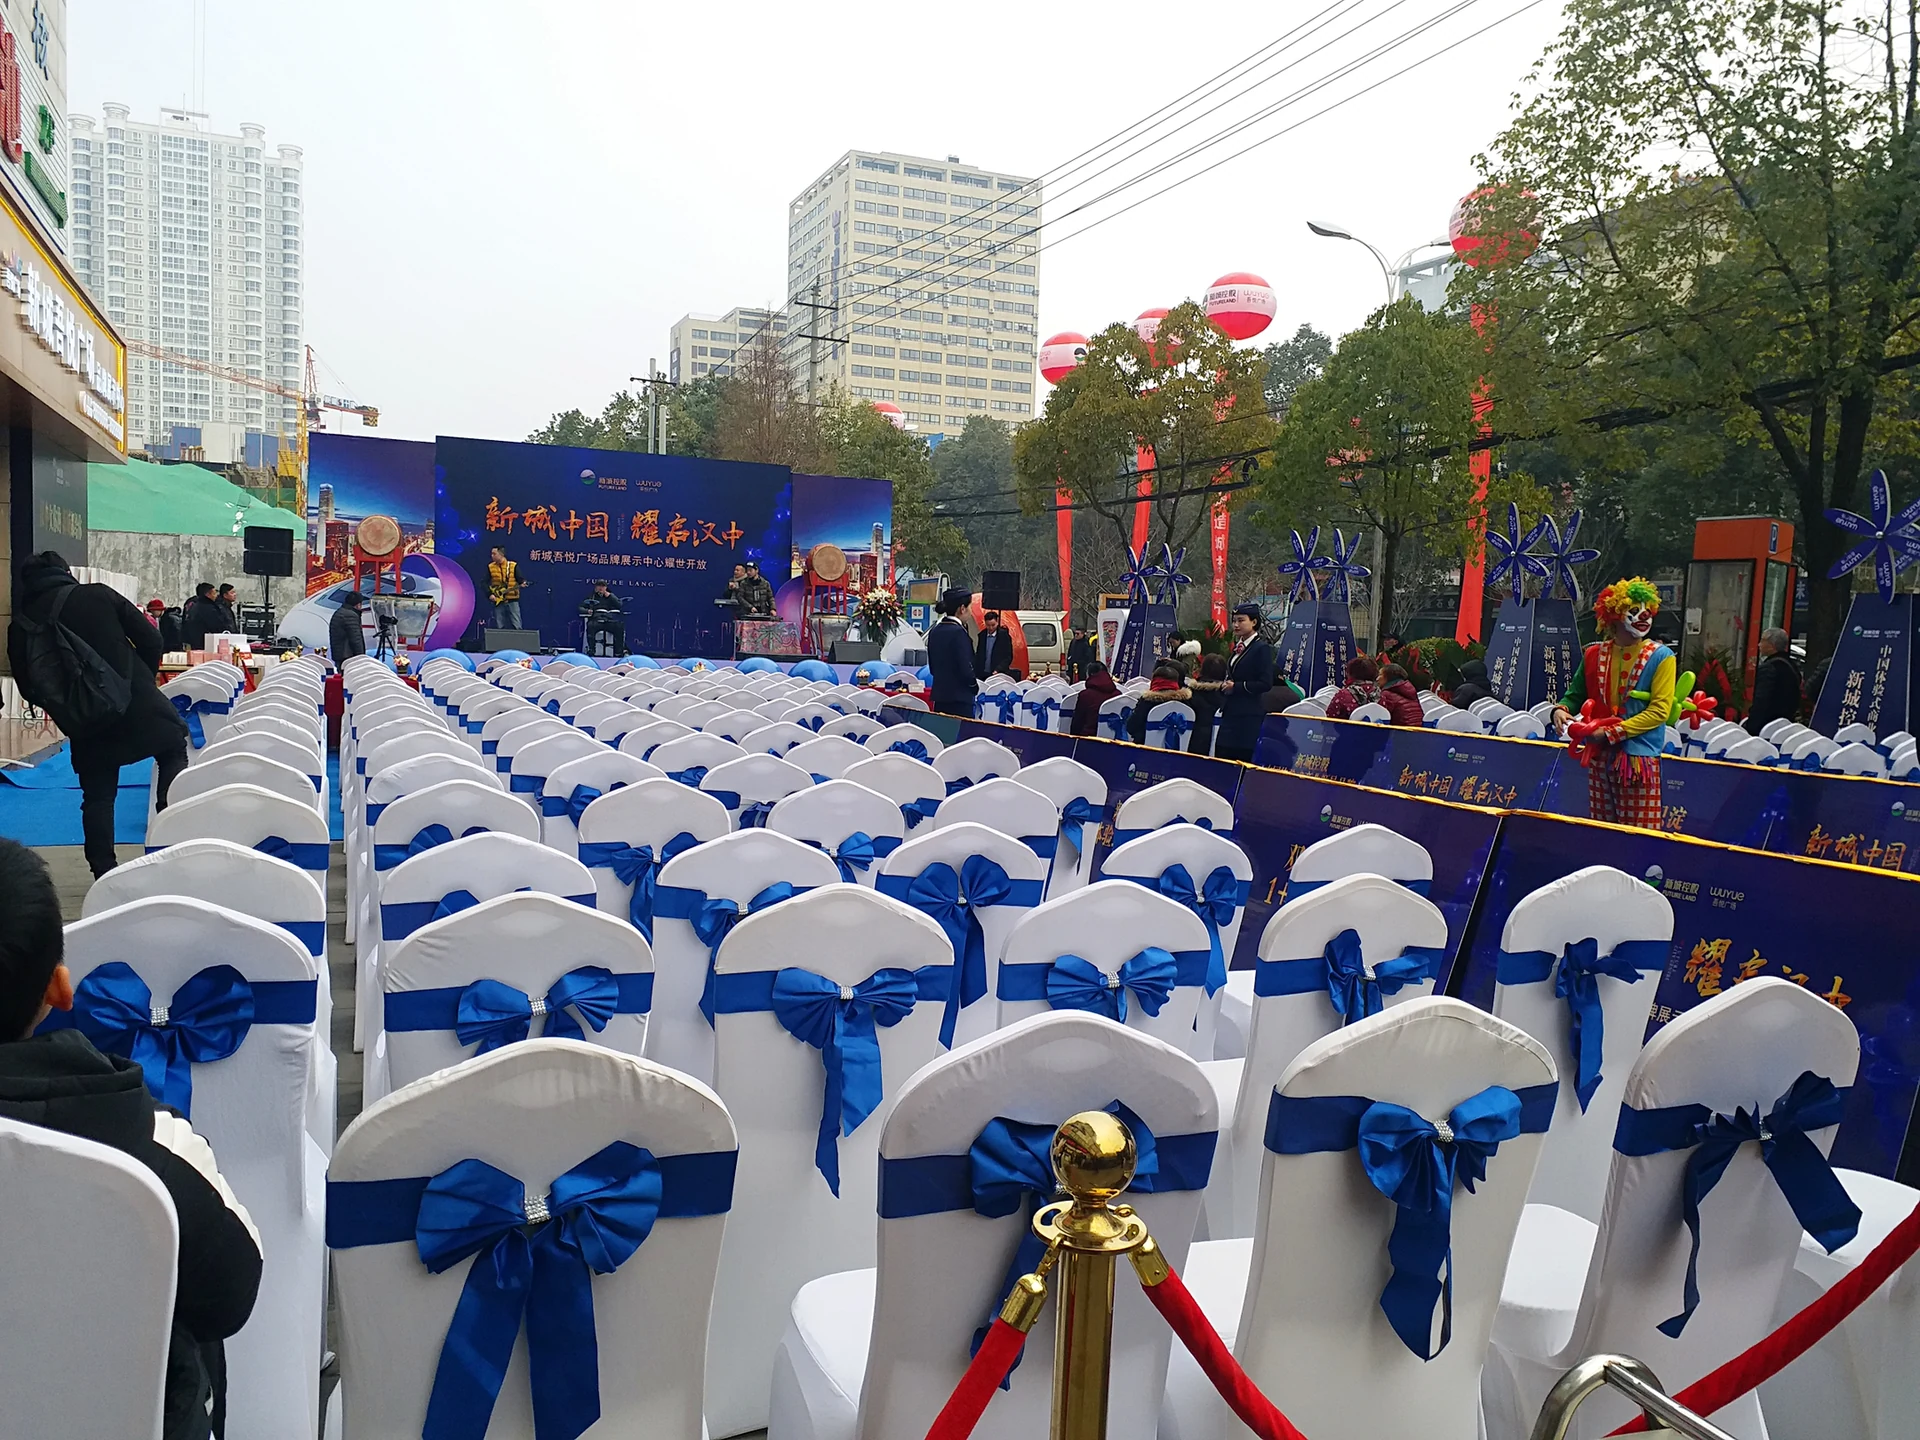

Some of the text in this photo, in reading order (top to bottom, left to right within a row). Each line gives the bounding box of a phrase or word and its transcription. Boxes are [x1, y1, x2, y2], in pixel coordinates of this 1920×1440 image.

[485, 496, 610, 543] 新城中国
[630, 509, 745, 550] 耀启汉中
[529, 549, 708, 571] 新城吾悦广场品牌展示中心耀世开放
[1804, 823, 1908, 872] 新城中国
[1664, 878, 1700, 895] 新城控股
[1682, 894, 1697, 902] LAND
[1712, 897, 1737, 911] 吾悦广场
